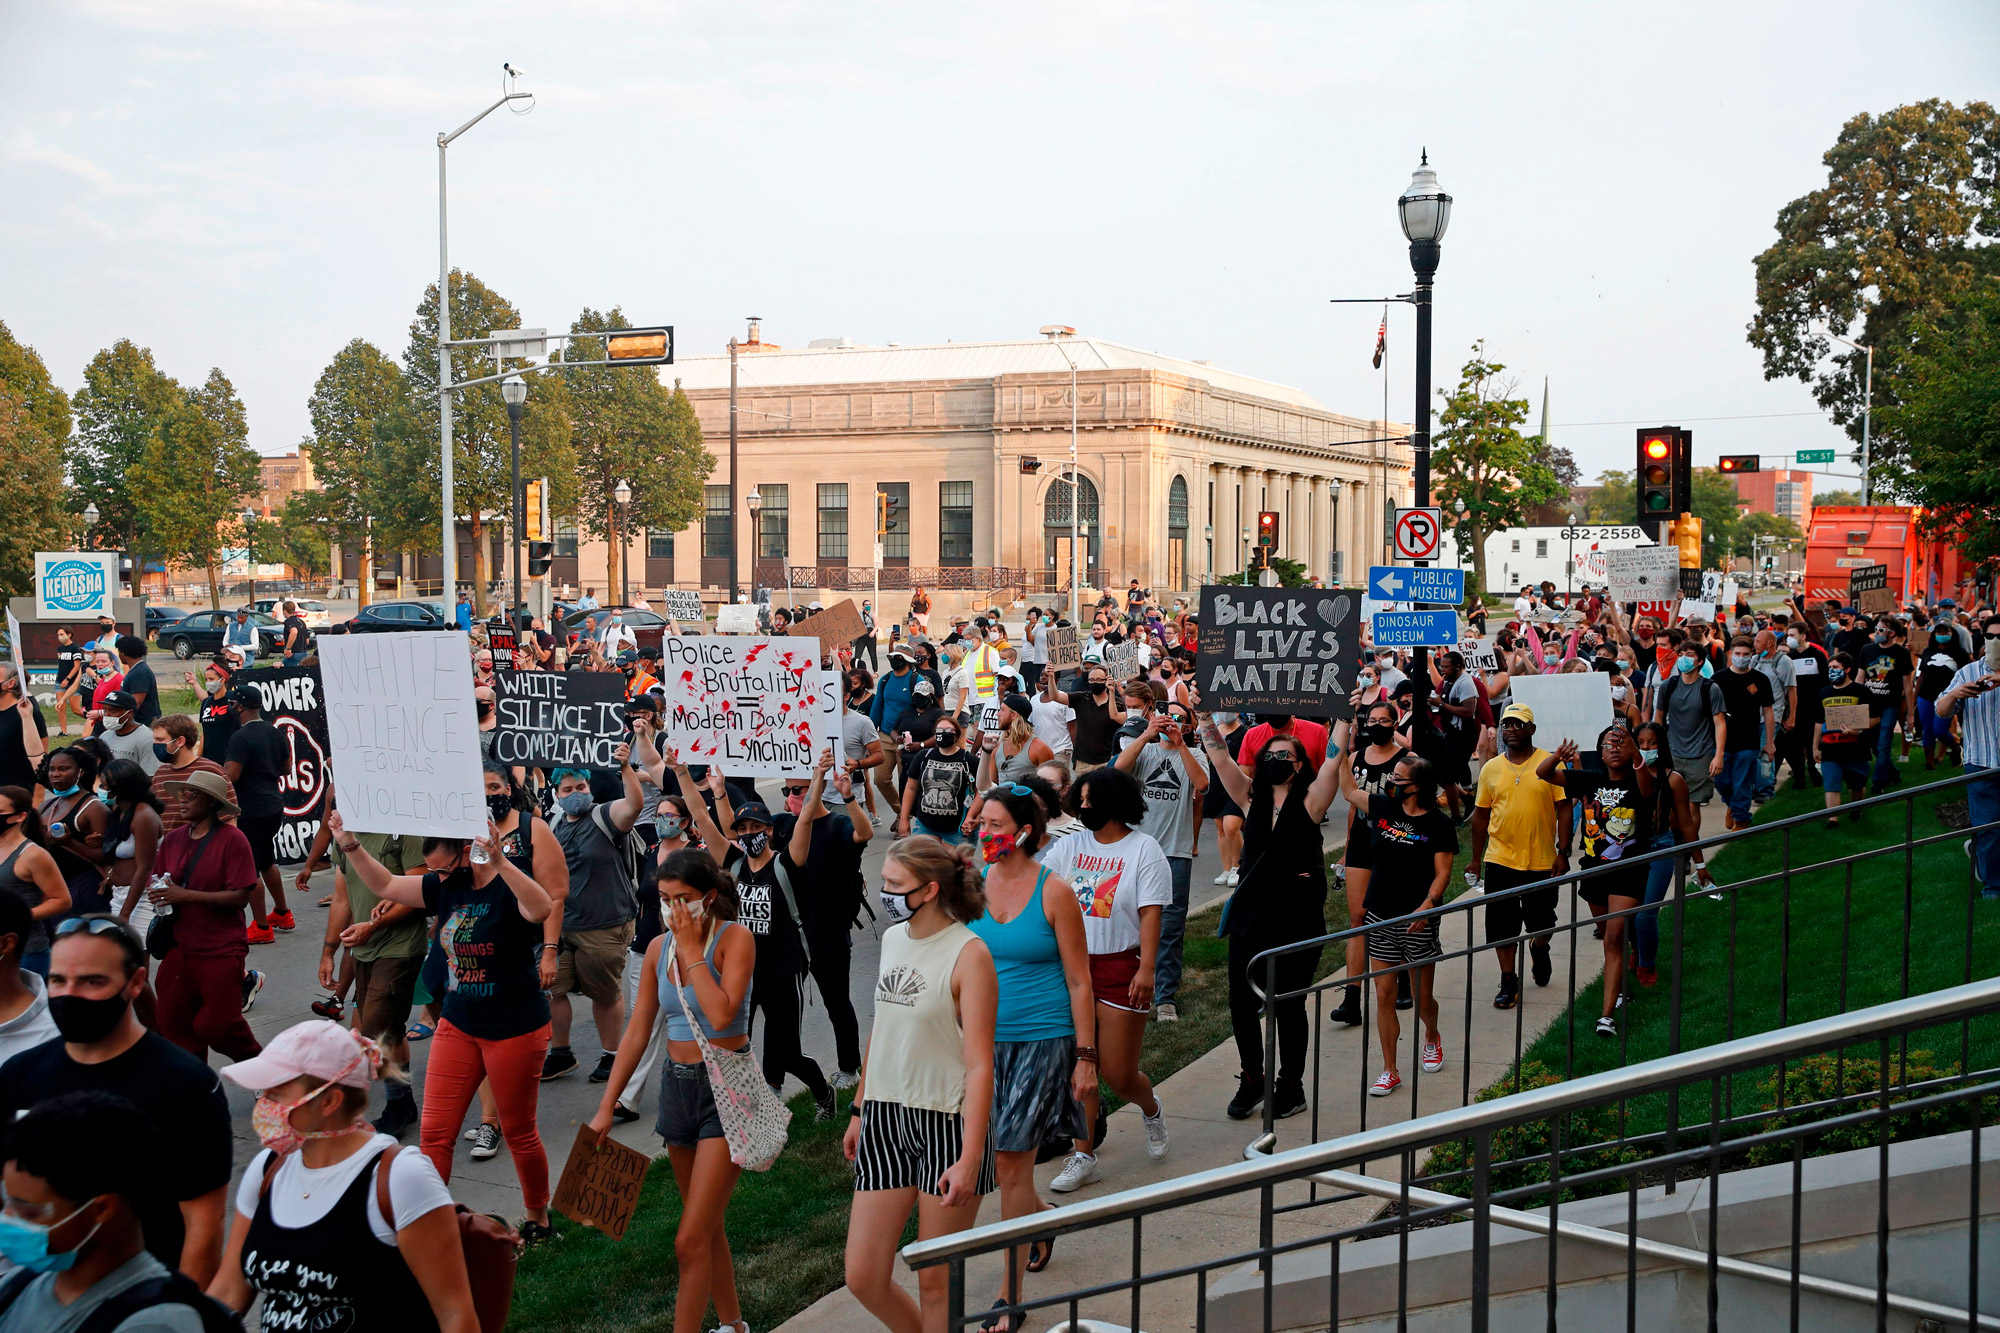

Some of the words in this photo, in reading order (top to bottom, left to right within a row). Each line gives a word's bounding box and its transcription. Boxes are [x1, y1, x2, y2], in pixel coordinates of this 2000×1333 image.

[1820, 452, 1831, 460] ST
[1561, 528, 1640, 540] 652-2558
[1413, 571, 1454, 586] PUBLIC
[1609, 575, 1638, 585] BLACK
[1647, 575, 1675, 585] LIVES
[1852, 569, 1866, 578] HOW
[1866, 566, 1885, 577] MANY
[45, 572, 103, 599] KENOSHA
[1409, 586, 1457, 601] MUSEUM
[1623, 588, 1663, 599] MATTER
[1852, 577, 1885, 593] WEREN'T
[664, 590, 686, 600] RACISM
[687, 591, 693, 600] IS
[694, 591, 700, 600] A
[1864, 592, 1893, 613] BLM
[666, 600, 685, 609] PUBLIC
[1213, 593, 1307, 626] BLACK
[667, 609, 702, 620] PROBLEM
[794, 607, 842, 634] SILENCE
[1378, 614, 1434, 628] DINOSAUR
[491, 635, 517, 649] CPAC
[1046, 630, 1056, 648] NO
[1056, 626, 1078, 645] JUSTICE
[1234, 629, 1340, 660] LIVES
[1379, 630, 1424, 643] MUSEUM
[493, 649, 513, 661] NOW
[667, 637, 736, 665] Police
[1048, 648, 1058, 665] NO
[1060, 645, 1078, 664] PEACE
[1107, 649, 1117, 662] NO
[1117, 641, 1138, 660] JUSTICE
[1457, 641, 1478, 651] END
[321, 636, 461, 700] WHITE
[1120, 659, 1138, 678] PEACE
[1464, 654, 1496, 669] OLENCE
[498, 672, 568, 699] WHITE
[703, 667, 803, 698] Brutality
[1209, 662, 1345, 695] MATTER
[499, 698, 593, 734] SILENCE
[594, 702, 625, 737] IS
[672, 704, 743, 731] Modern
[750, 711, 787, 730] Day
[333, 702, 465, 754] SILENCE
[497, 730, 624, 768] COMPLIANCE
[725, 732, 812, 766] Lynching
[363, 750, 435, 775] EQUALS
[341, 782, 477, 822] VIOLENCE
[921, 806, 958, 816] DOWN
[1377, 818, 1429, 842] Aeropostale
[737, 883, 770, 902] BLACK
[740, 902, 770, 920] IVES
[739, 919, 770, 934] ATTER
[455, 929, 474, 943] THE
[454, 943, 495, 957] THINGS
[458, 957, 478, 969] YOU
[455, 969, 487, 983] CARE
[457, 983, 496, 997] ABOUT
[875, 992, 920, 1007] TRIARCHY
[600, 1167, 637, 1202] SMALL
[260, 1260, 290, 1281] see
[296, 1263, 339, 1290] you
